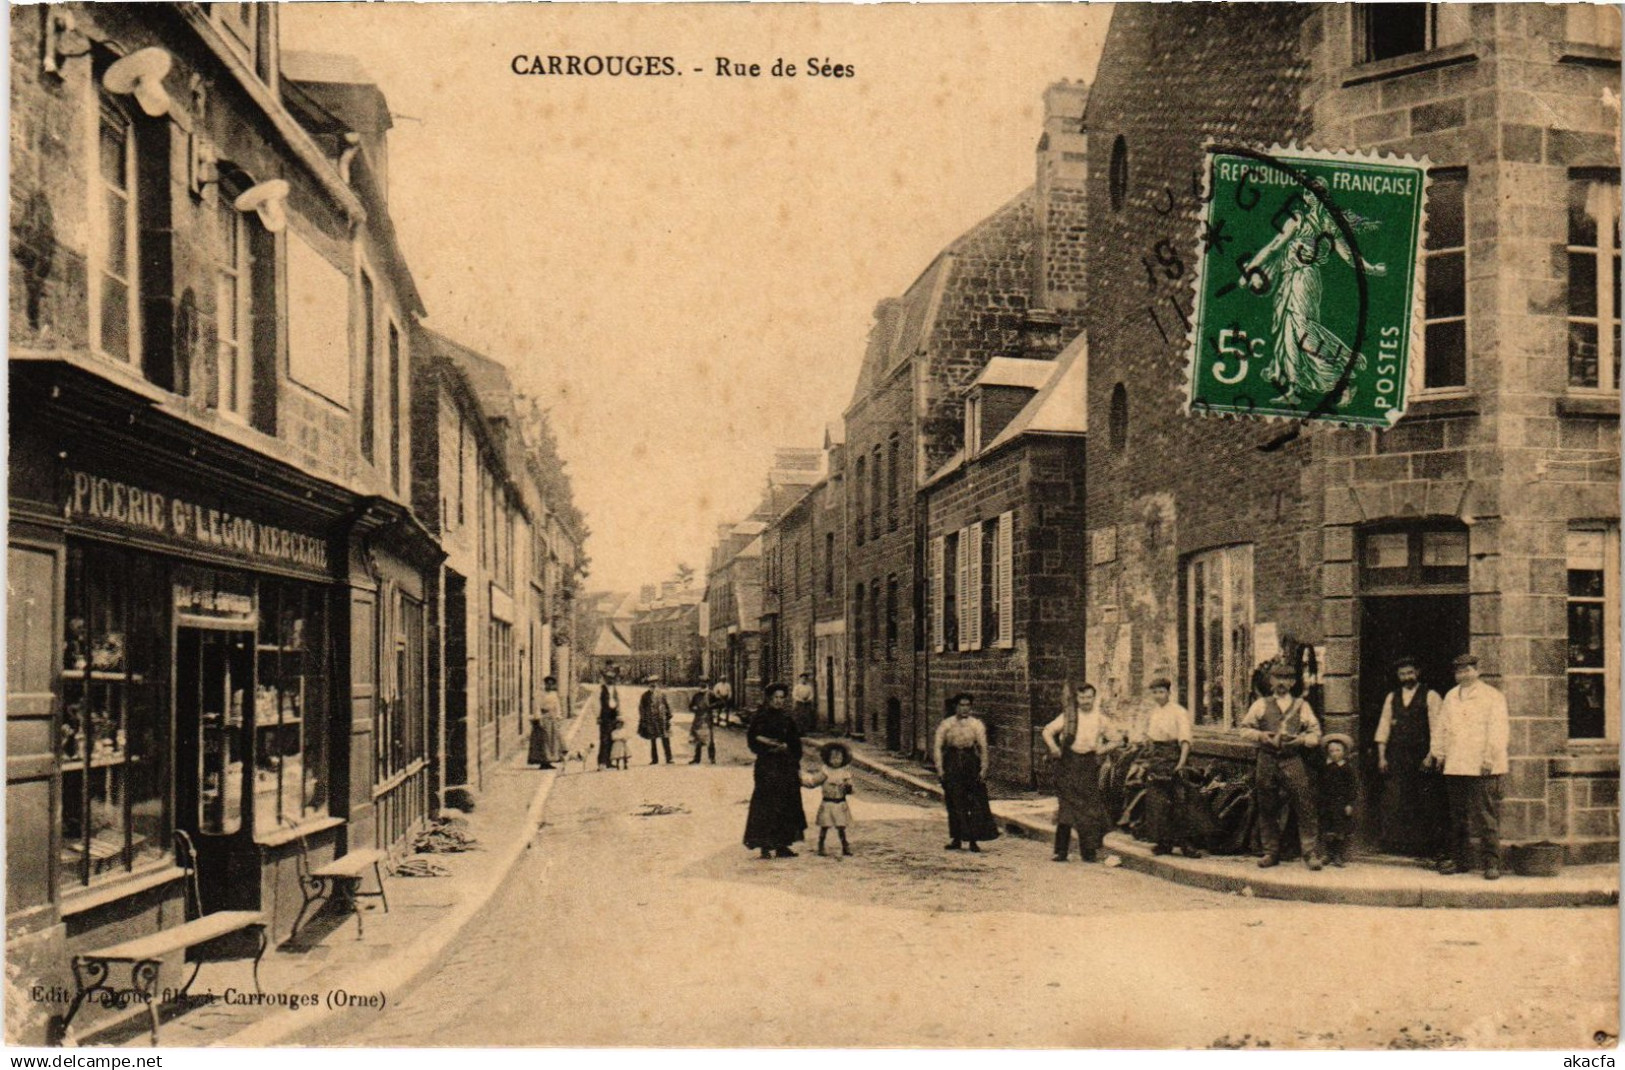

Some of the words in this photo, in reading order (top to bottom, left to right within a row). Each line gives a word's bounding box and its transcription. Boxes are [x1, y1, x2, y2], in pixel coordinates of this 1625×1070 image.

[1333, 172, 1412, 195] FRANÇAISE
[1374, 326, 1400, 409] POSTES
[258, 524, 328, 569] MERCERIE
